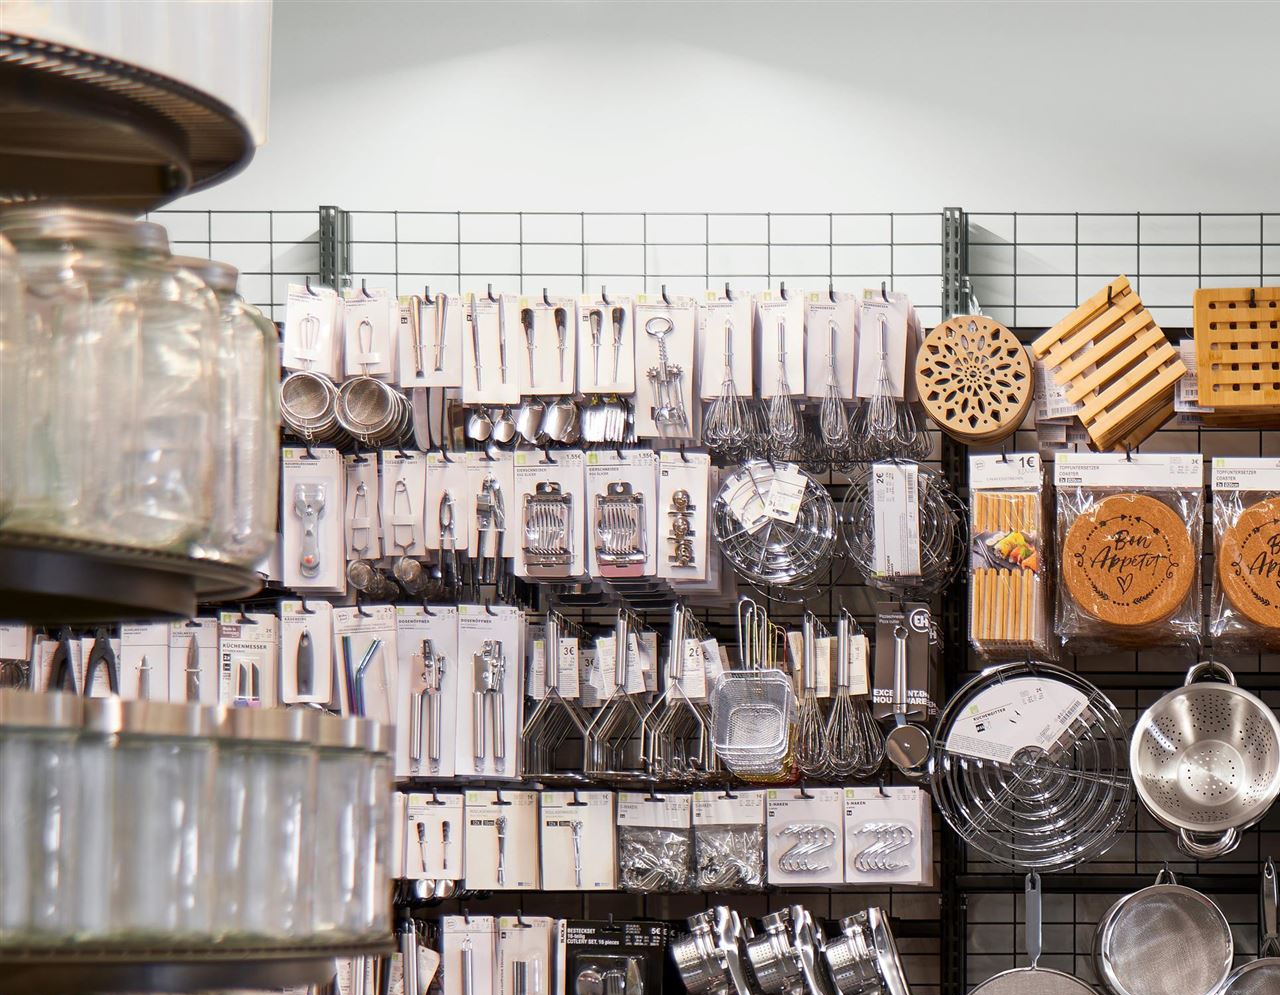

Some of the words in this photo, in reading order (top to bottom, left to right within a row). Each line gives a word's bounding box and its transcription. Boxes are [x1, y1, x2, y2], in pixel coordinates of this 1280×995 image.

[1019, 456, 1035, 468] 1€
[876, 472, 884, 484] 2€
[1114, 529, 1152, 551] Bon
[1090, 546, 1168, 576] Appétit
[222, 642, 268, 650] KÜCHENMESSER
[563, 646, 575, 656] 3€
[689, 647, 700, 657] 2€
[584, 658, 594, 667] 3€
